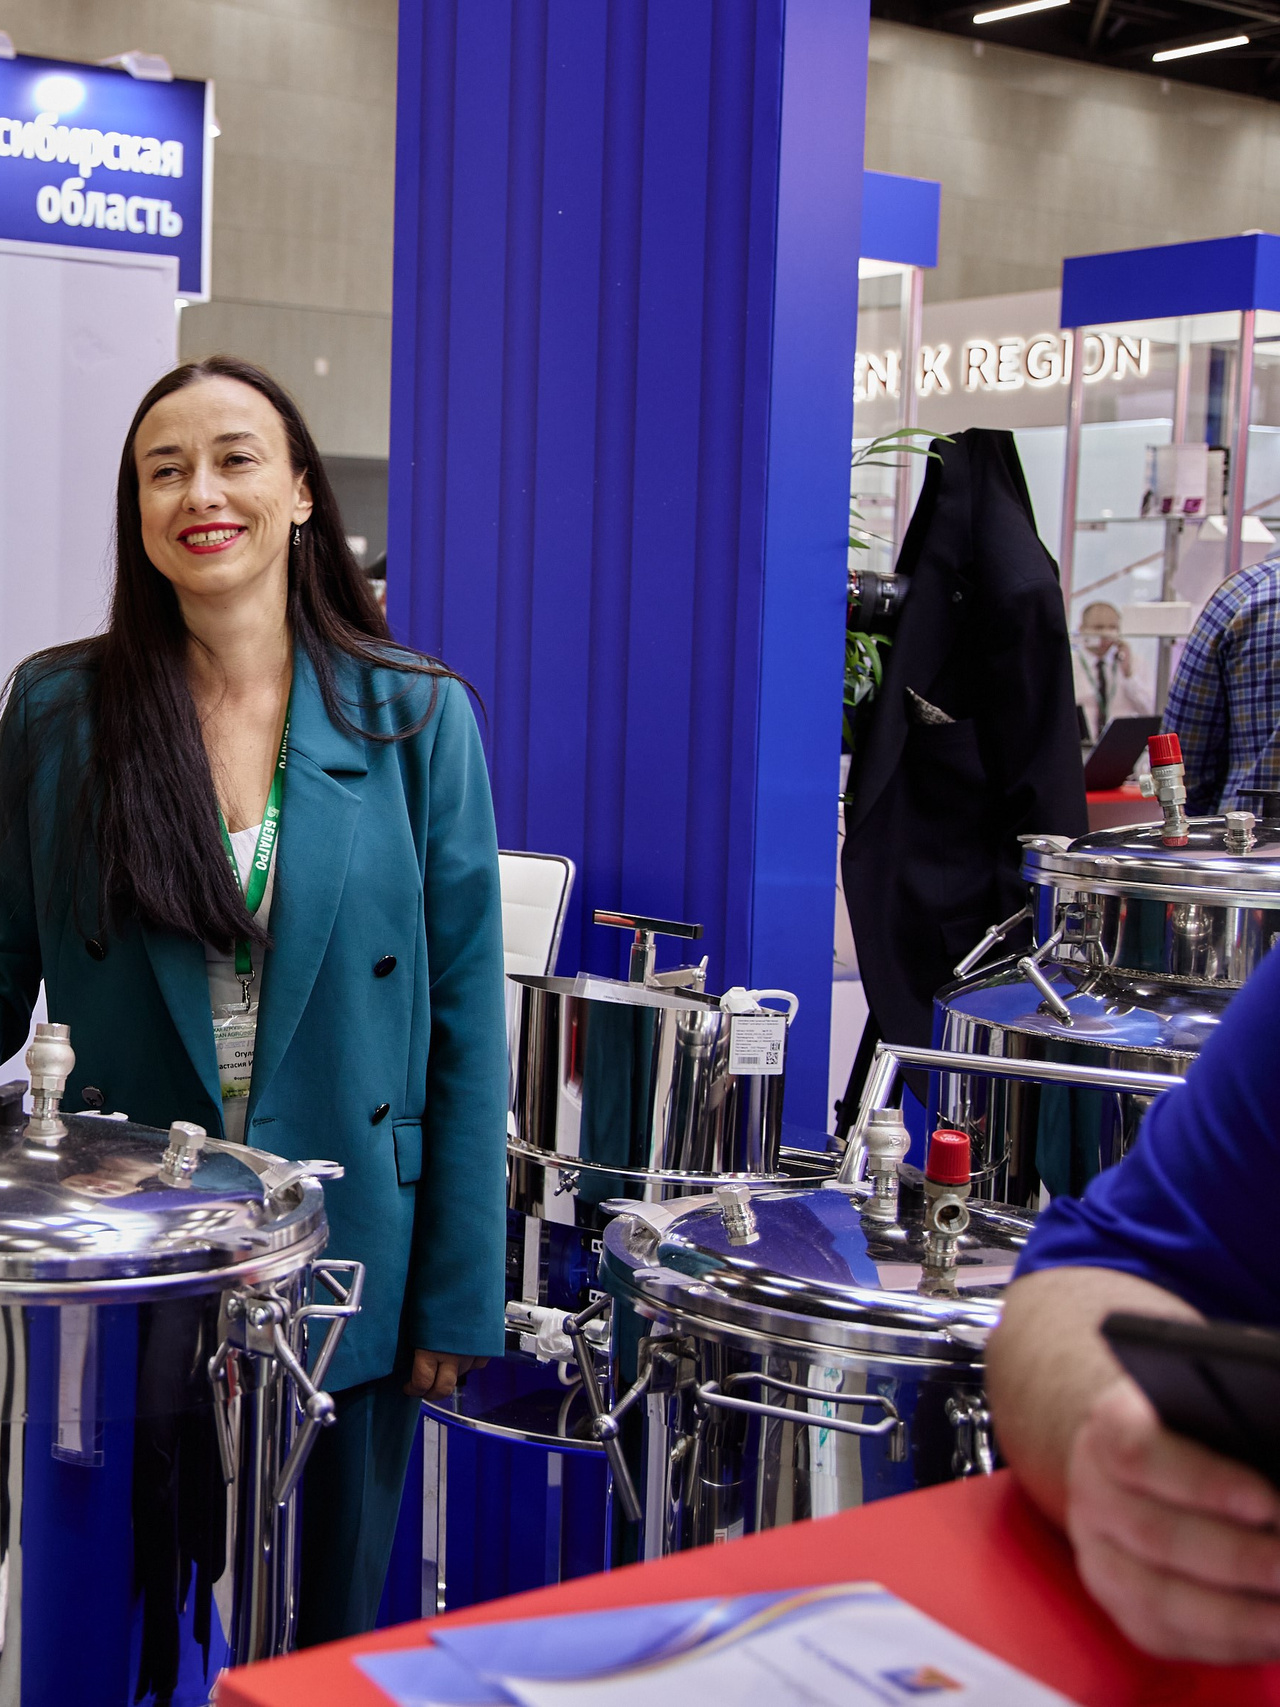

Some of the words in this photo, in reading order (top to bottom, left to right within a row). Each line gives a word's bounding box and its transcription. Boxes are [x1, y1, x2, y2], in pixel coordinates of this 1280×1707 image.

[36, 176, 184, 238] область
[962, 332, 1150, 393] REGION
[255, 818, 277, 871] БЕЛАГРО
[219, 1061, 247, 1070] астасия
